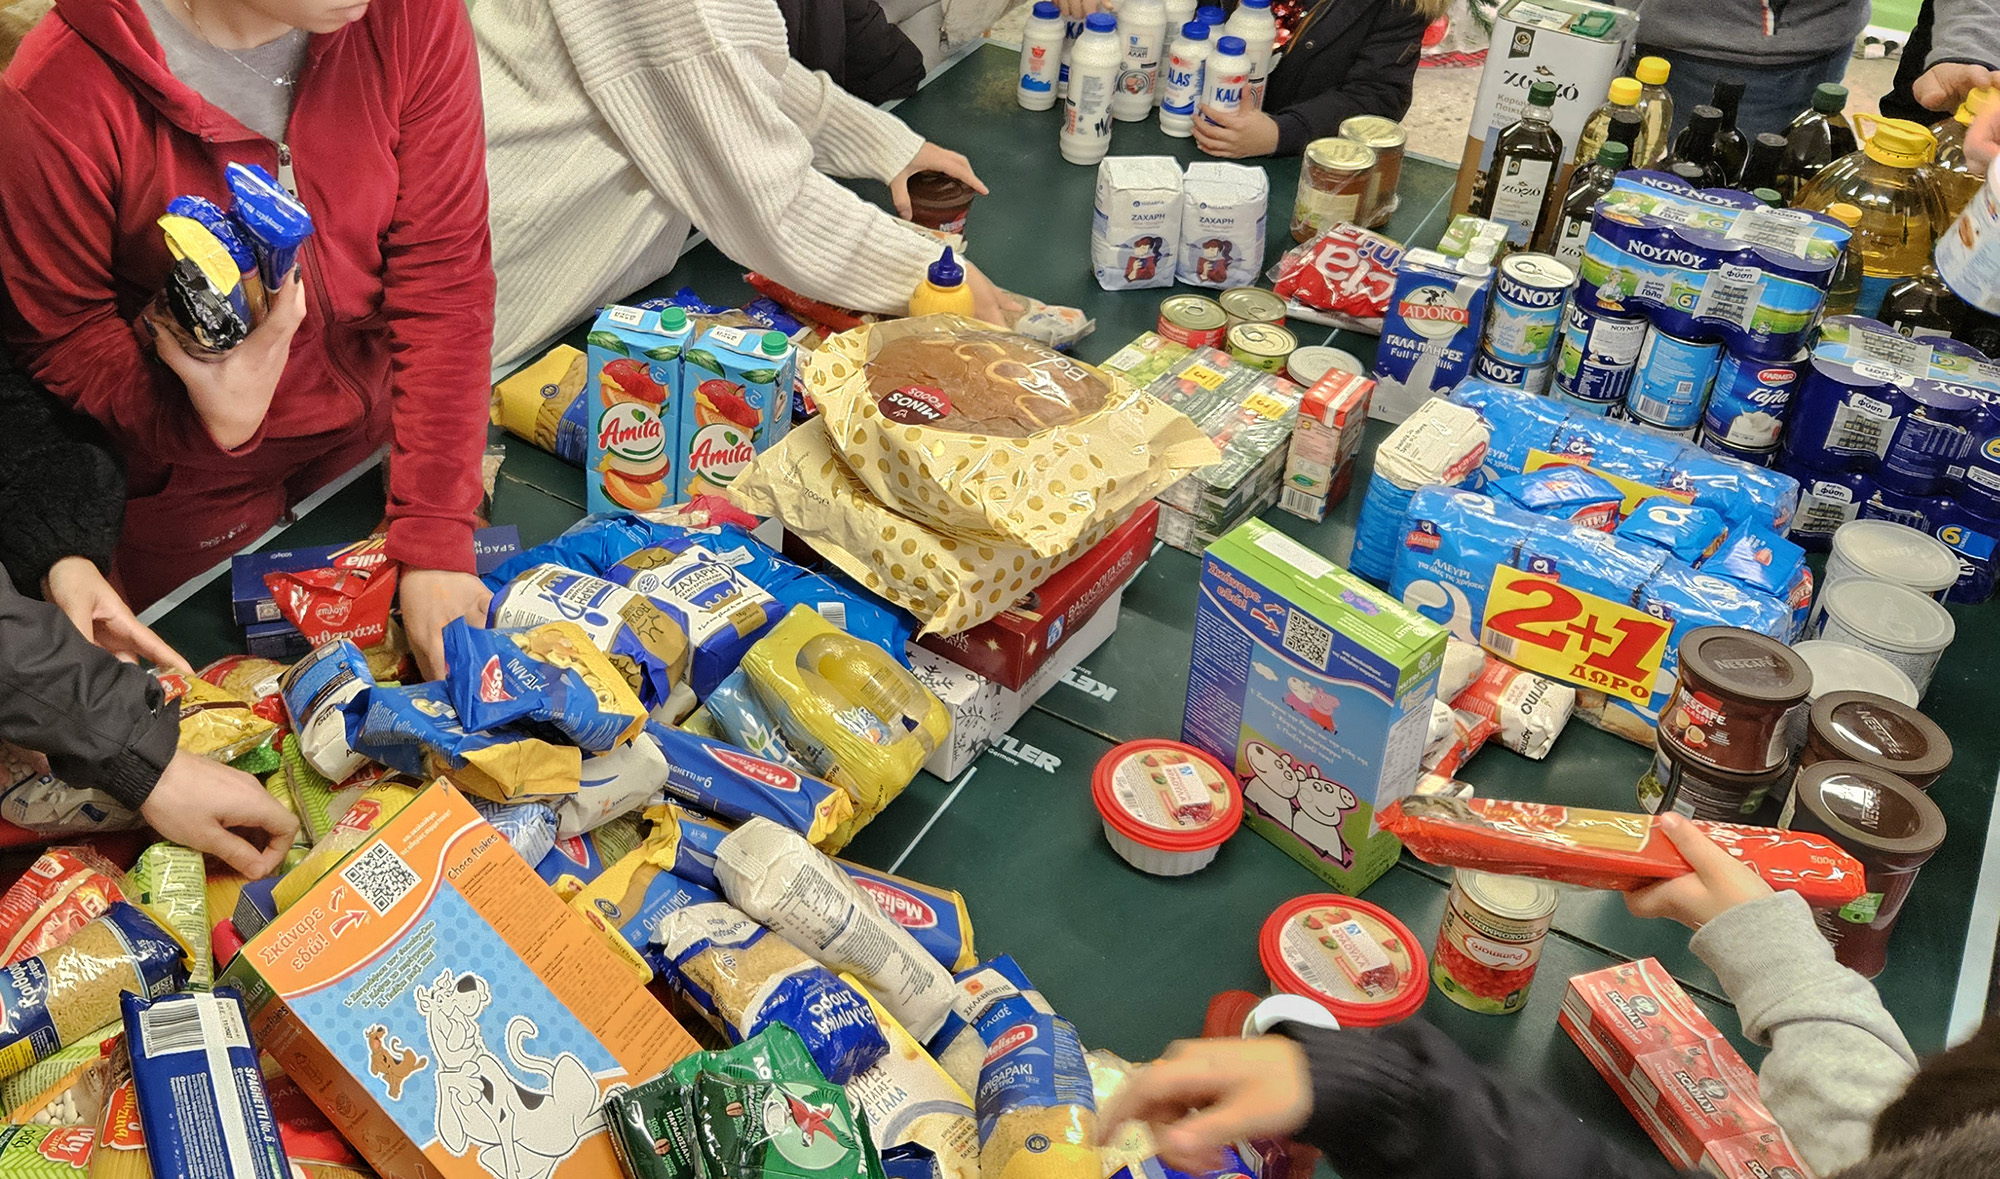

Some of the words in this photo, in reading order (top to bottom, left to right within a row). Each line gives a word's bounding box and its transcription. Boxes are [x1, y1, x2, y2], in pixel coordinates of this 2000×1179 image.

[1403, 305, 1466, 323] ADORO
[1386, 334, 1417, 350] ΓΑΛΑ
[888, 392, 940, 420] MINOS
[907, 387, 945, 410] FOODS
[599, 417, 661, 450] Amita
[690, 438, 753, 471] Amita
[670, 566, 716, 597] ΖΑΧΑΡΗ
[1208, 561, 1262, 602] Σκάναρε
[1433, 557, 1471, 580] ΑΛΕΥΡΙ
[1486, 579, 1668, 683] 2+1
[1569, 664, 1650, 700] ΔΩΡΟ
[447, 857, 474, 880] Choco
[257, 907, 326, 966] Σκάναρε
[291, 933, 331, 972] εδώ!
[1471, 941, 1524, 961] Pummaro
[963, 983, 1012, 1016] ΣΚΛΑΒΕΝΙΤΗΣ
[1608, 991, 1646, 1029] KYKNOS
[980, 1063, 1033, 1099] ΚΡΙΘΑΡΑΚΙ
